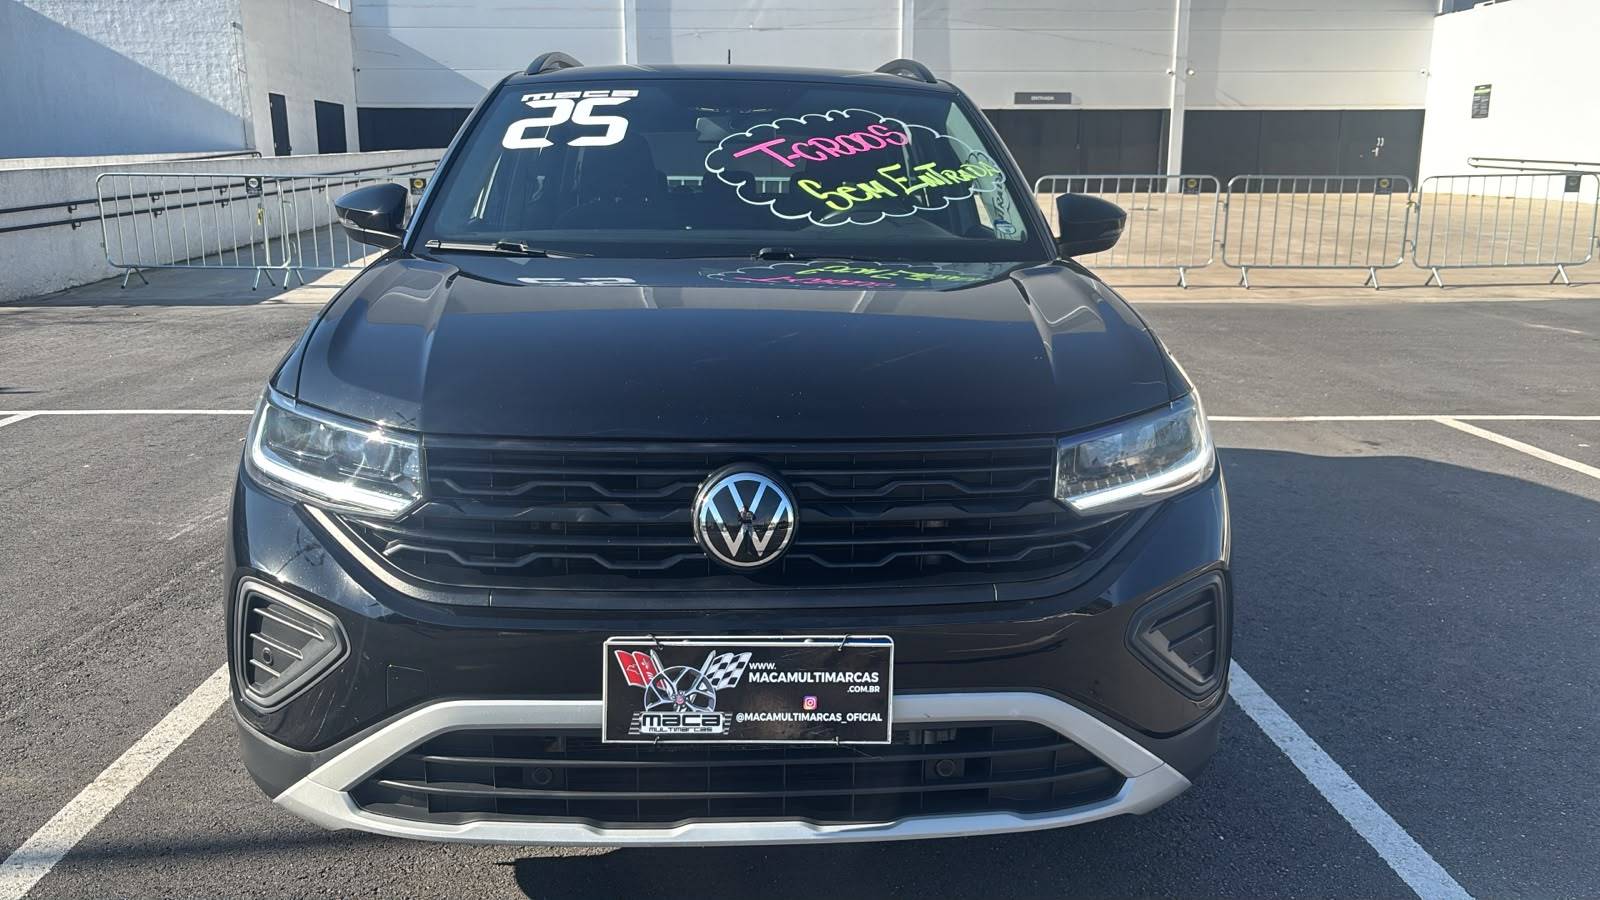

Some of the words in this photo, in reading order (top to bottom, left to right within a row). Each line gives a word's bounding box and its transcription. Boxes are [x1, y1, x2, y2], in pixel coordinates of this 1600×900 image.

[502, 98, 631, 149] 25
[748, 671, 880, 683] MACAMULTIMARCAS
[847, 685, 880, 693] .COM.BR
[735, 712, 883, 724] @MACAMULTIMARCAS_OFICIAL
